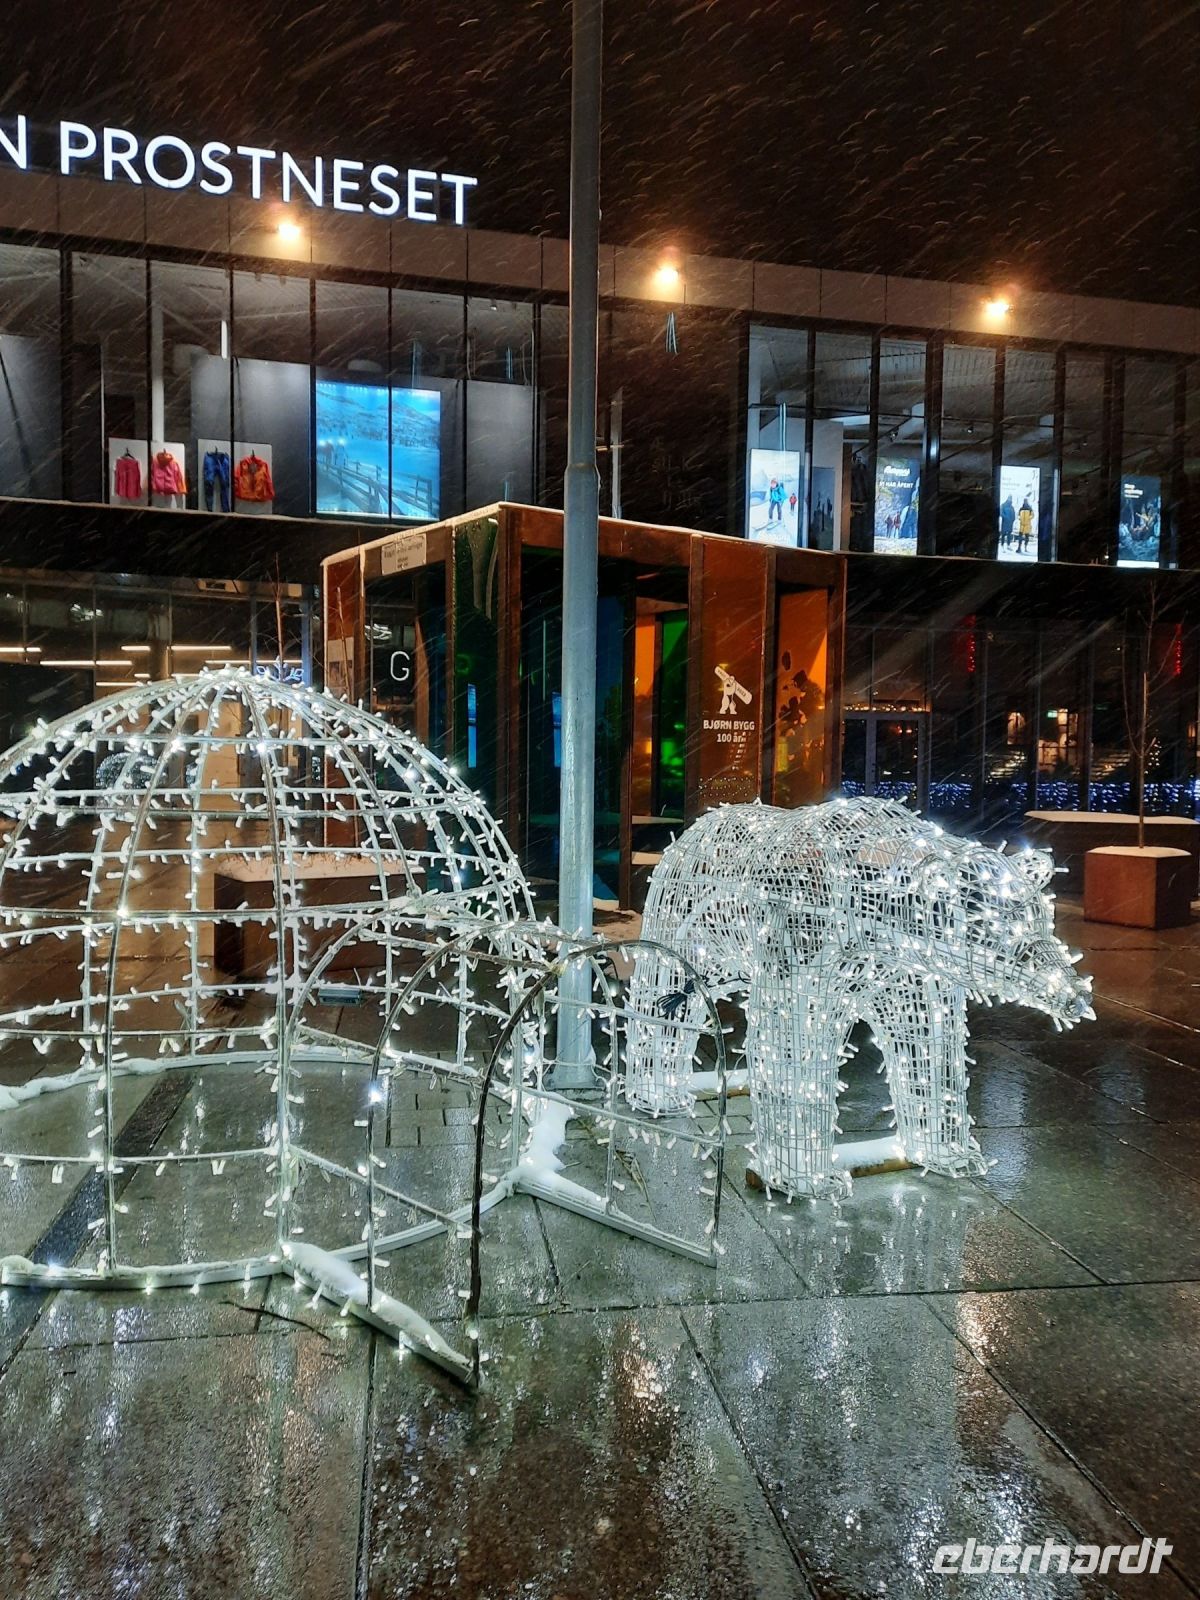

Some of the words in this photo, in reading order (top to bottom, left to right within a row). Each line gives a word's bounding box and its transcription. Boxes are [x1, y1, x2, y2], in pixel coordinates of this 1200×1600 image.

[60, 120, 479, 225] PROSTNESET
[390, 650, 410, 682] G
[703, 719, 732, 730] BJØRN
[733, 720, 755, 731] BYGG
[716, 733, 732, 743] 100
